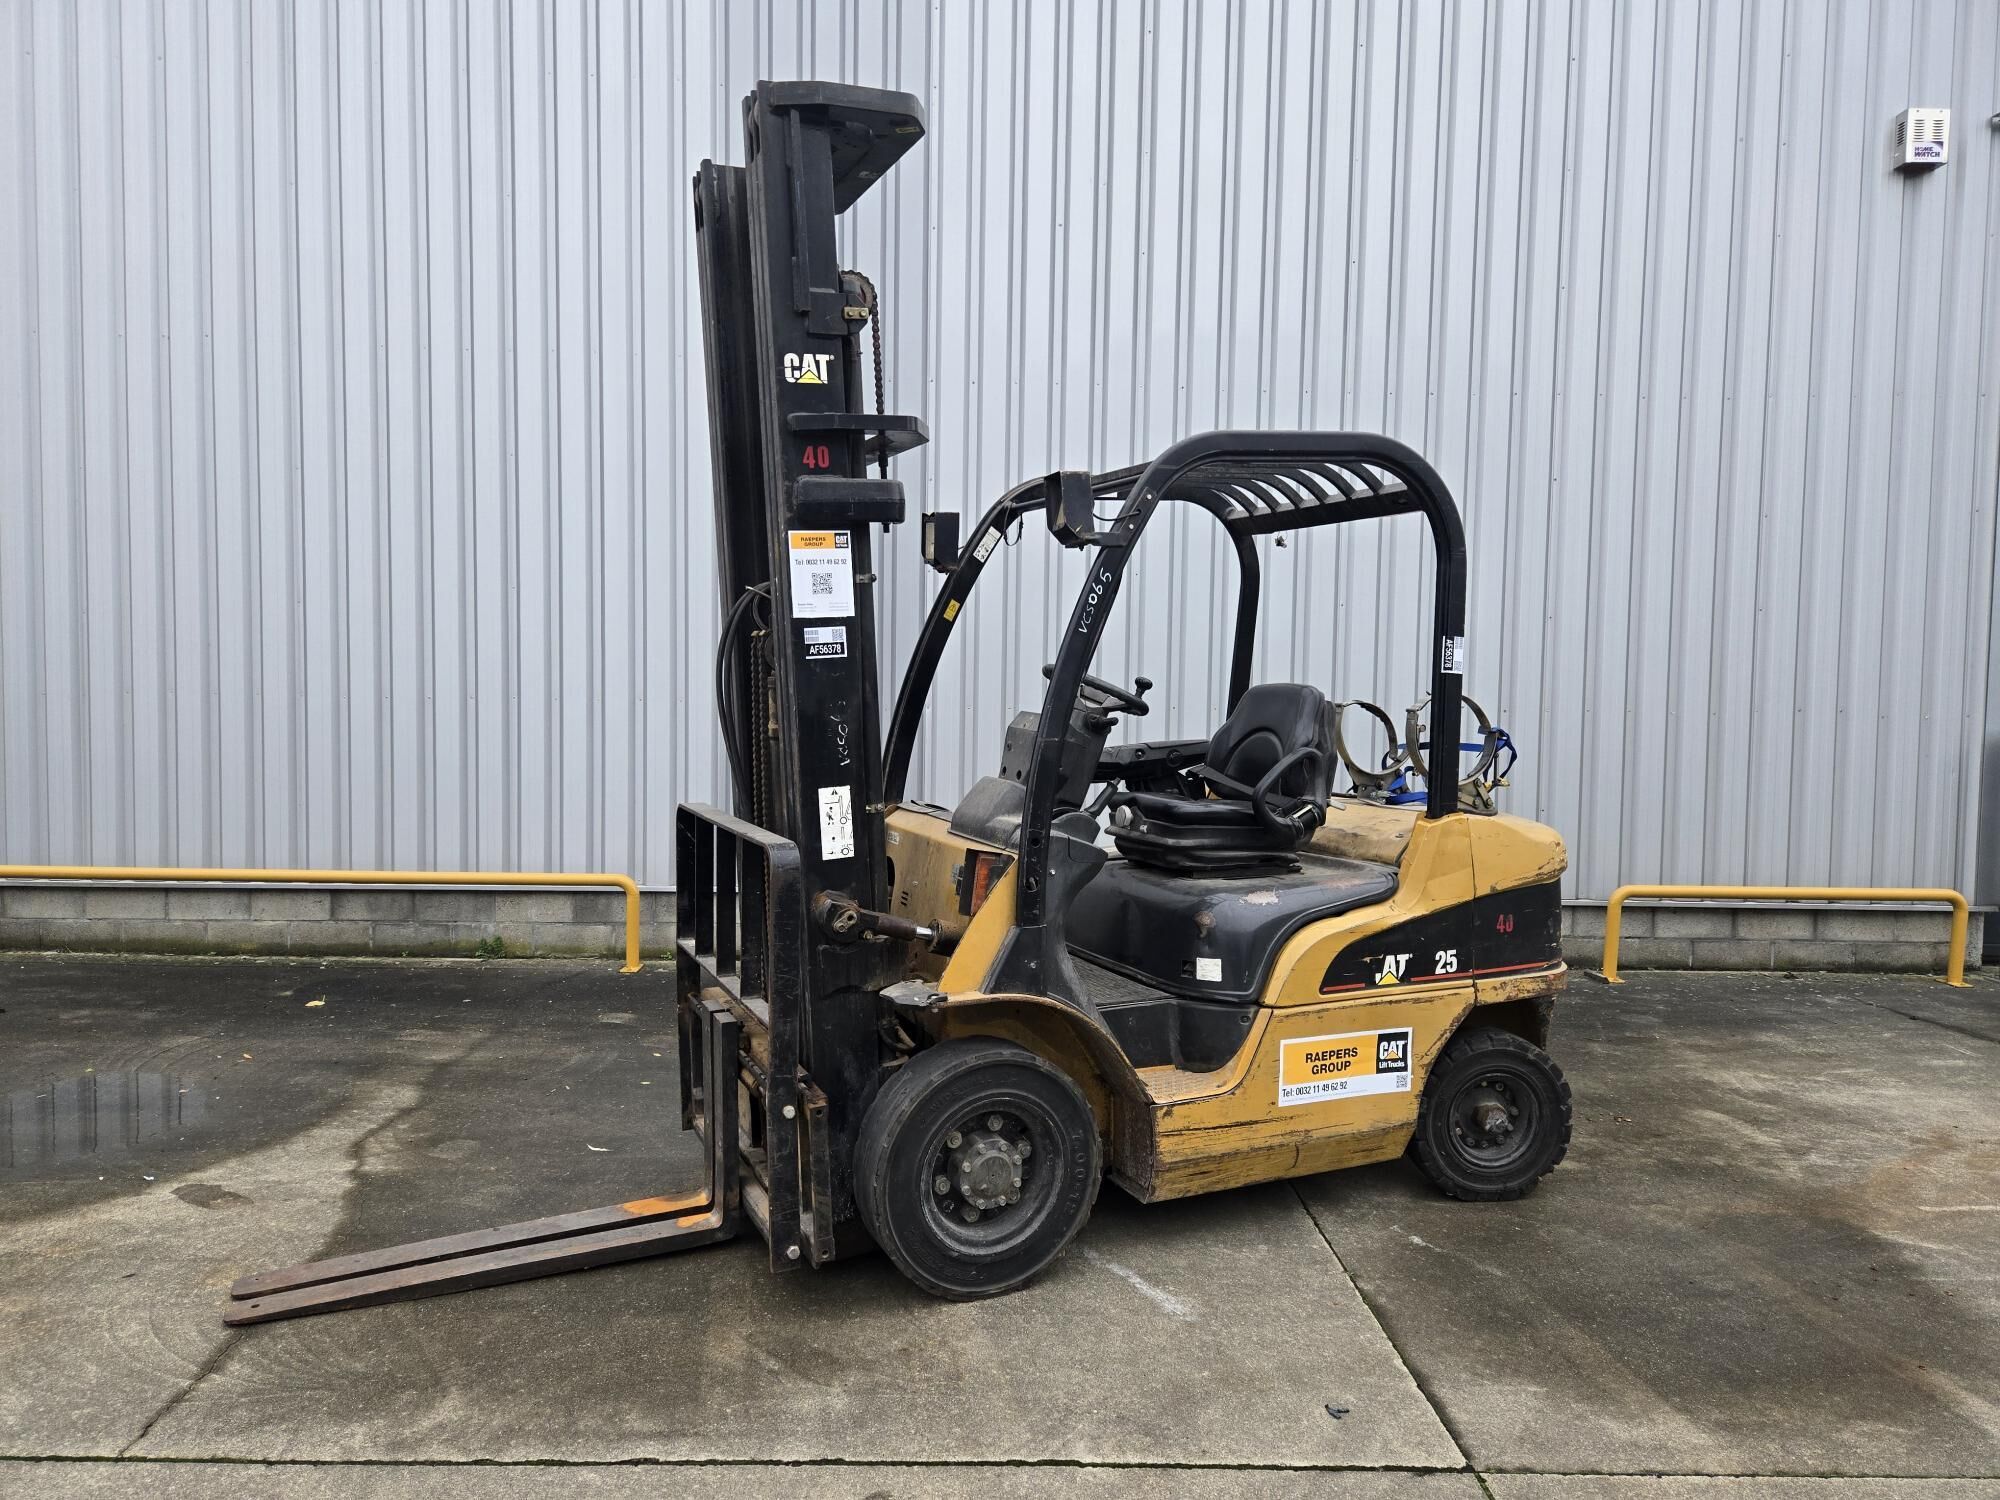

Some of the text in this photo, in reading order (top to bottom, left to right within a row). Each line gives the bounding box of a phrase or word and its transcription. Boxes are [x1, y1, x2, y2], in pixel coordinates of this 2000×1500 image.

[783, 352, 831, 384] CAT
[802, 445, 830, 469] 40
[836, 536, 848, 544] CAT
[810, 644, 842, 654] AF56378
[1444, 639, 1454, 668] AF56378
[1496, 914, 1514, 933] 40
[1375, 950, 1457, 984] AT 25
[1306, 1047, 1358, 1064] RAEPERS
[1379, 1040, 1406, 1060] CAT
[1312, 1062, 1352, 1075] GROUP
[1282, 1088, 1294, 1098] Tel:
[1296, 1085, 1311, 1096] 0032
[1313, 1084, 1320, 1094] 11
[1322, 1084, 1330, 1092] 49
[1330, 1082, 1338, 1091] 62
[1340, 1081, 1348, 1090] 92
